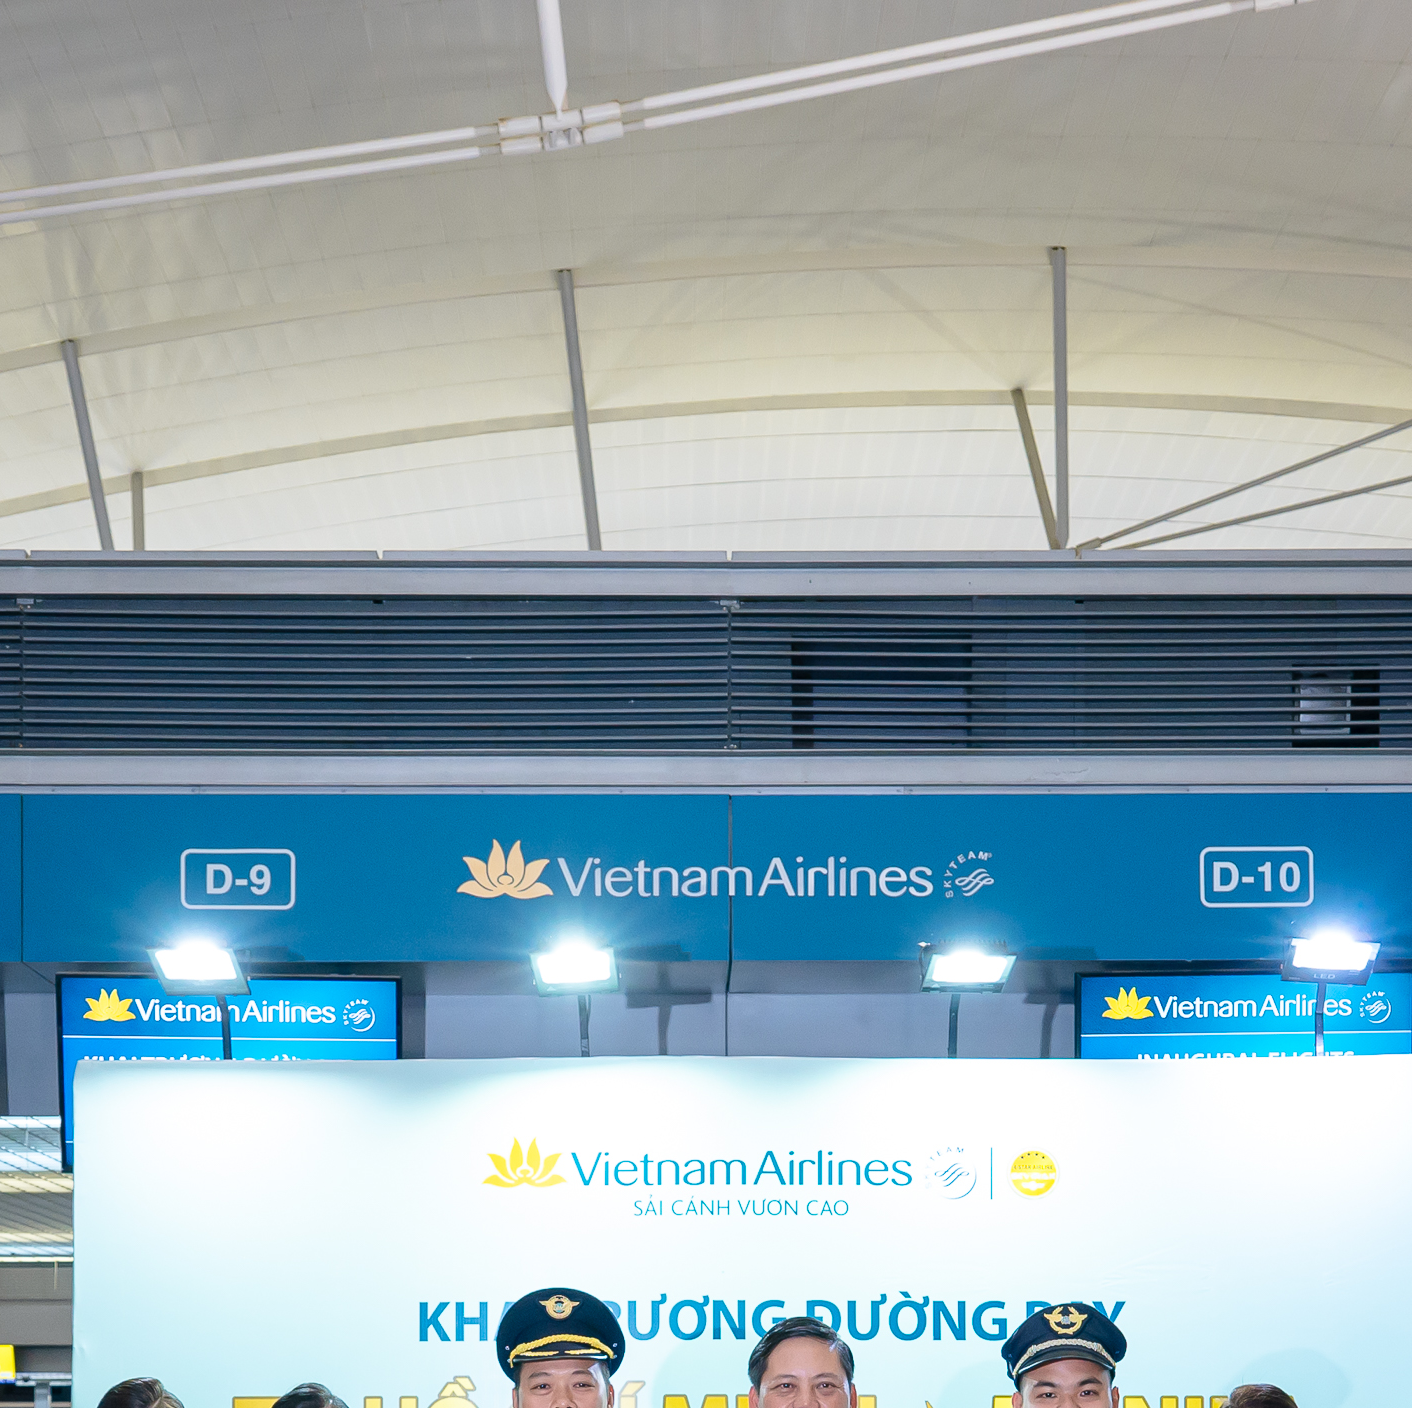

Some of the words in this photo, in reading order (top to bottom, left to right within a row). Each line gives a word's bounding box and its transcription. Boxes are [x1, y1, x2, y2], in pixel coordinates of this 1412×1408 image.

[205, 863, 272, 897] D-9
[557, 857, 753, 897] Vietnam
[758, 856, 934, 897] Airlines
[942, 850, 988, 899] SKYTEAM
[1213, 861, 1301, 893] D-10
[134, 999, 240, 1022] Vietnam
[241, 999, 336, 1024] Airlines
[1153, 995, 1257, 1019] Vietnam
[571, 1151, 747, 1186] Vietnam
[753, 1150, 913, 1186] Airlines
[633, 1194, 663, 1216] SẢI
[671, 1195, 730, 1216] CÁNH
[806, 1200, 849, 1217] CAO
